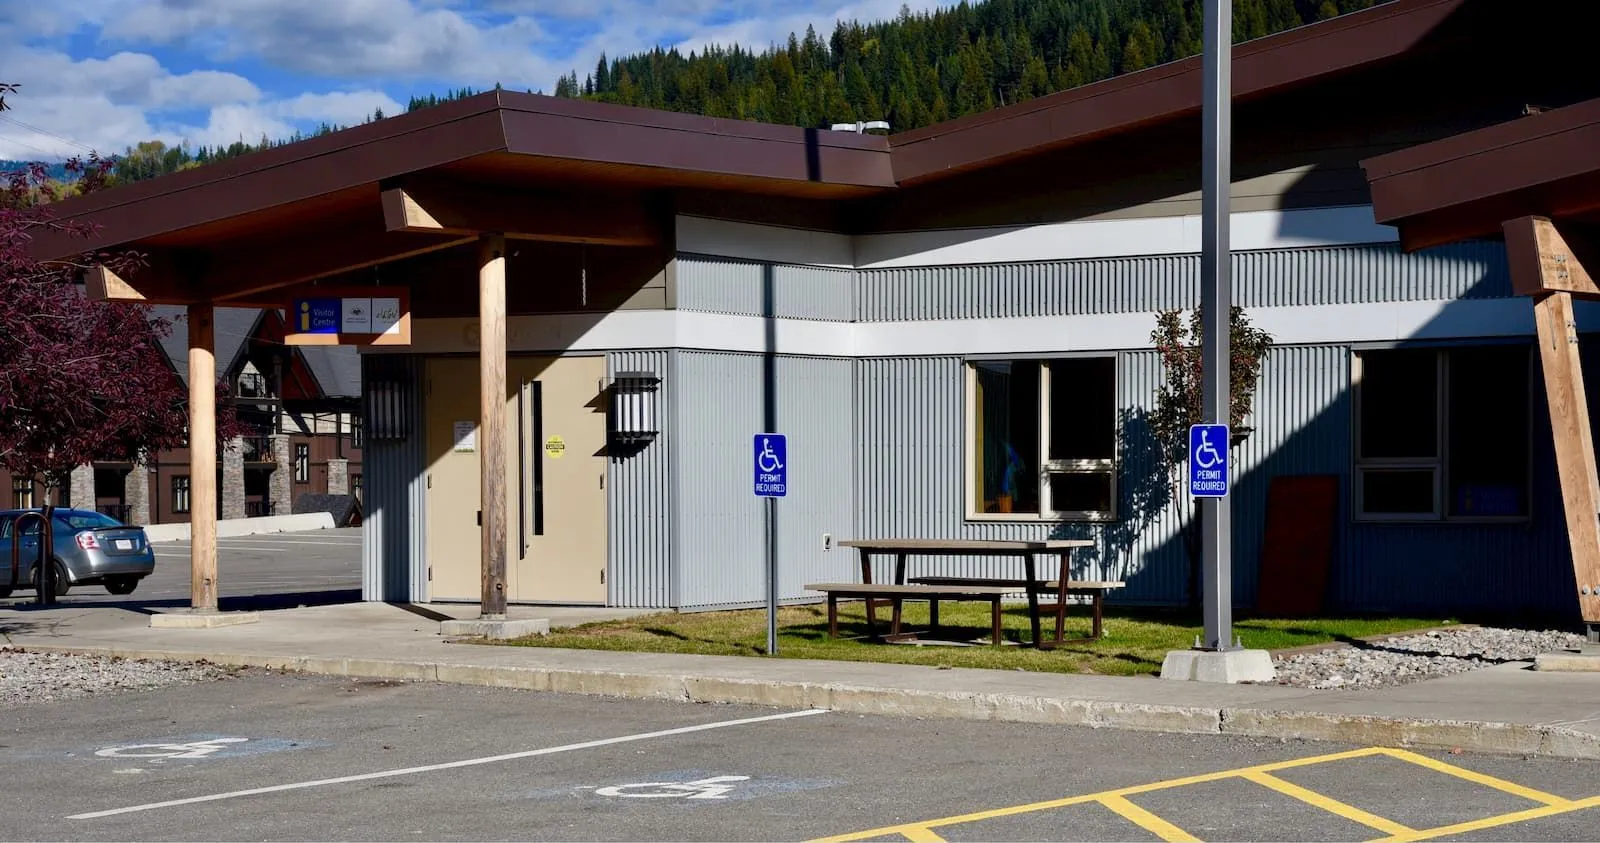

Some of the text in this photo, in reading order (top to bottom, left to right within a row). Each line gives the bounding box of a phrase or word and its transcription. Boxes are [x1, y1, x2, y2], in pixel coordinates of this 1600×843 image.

[313, 308, 335, 316] Visitor
[312, 317, 336, 326] Centre
[760, 473, 781, 483] PERMIT
[1197, 470, 1221, 480] PERMIT
[756, 483, 785, 493] REQUIRED
[1193, 481, 1225, 491] REQUIRED
